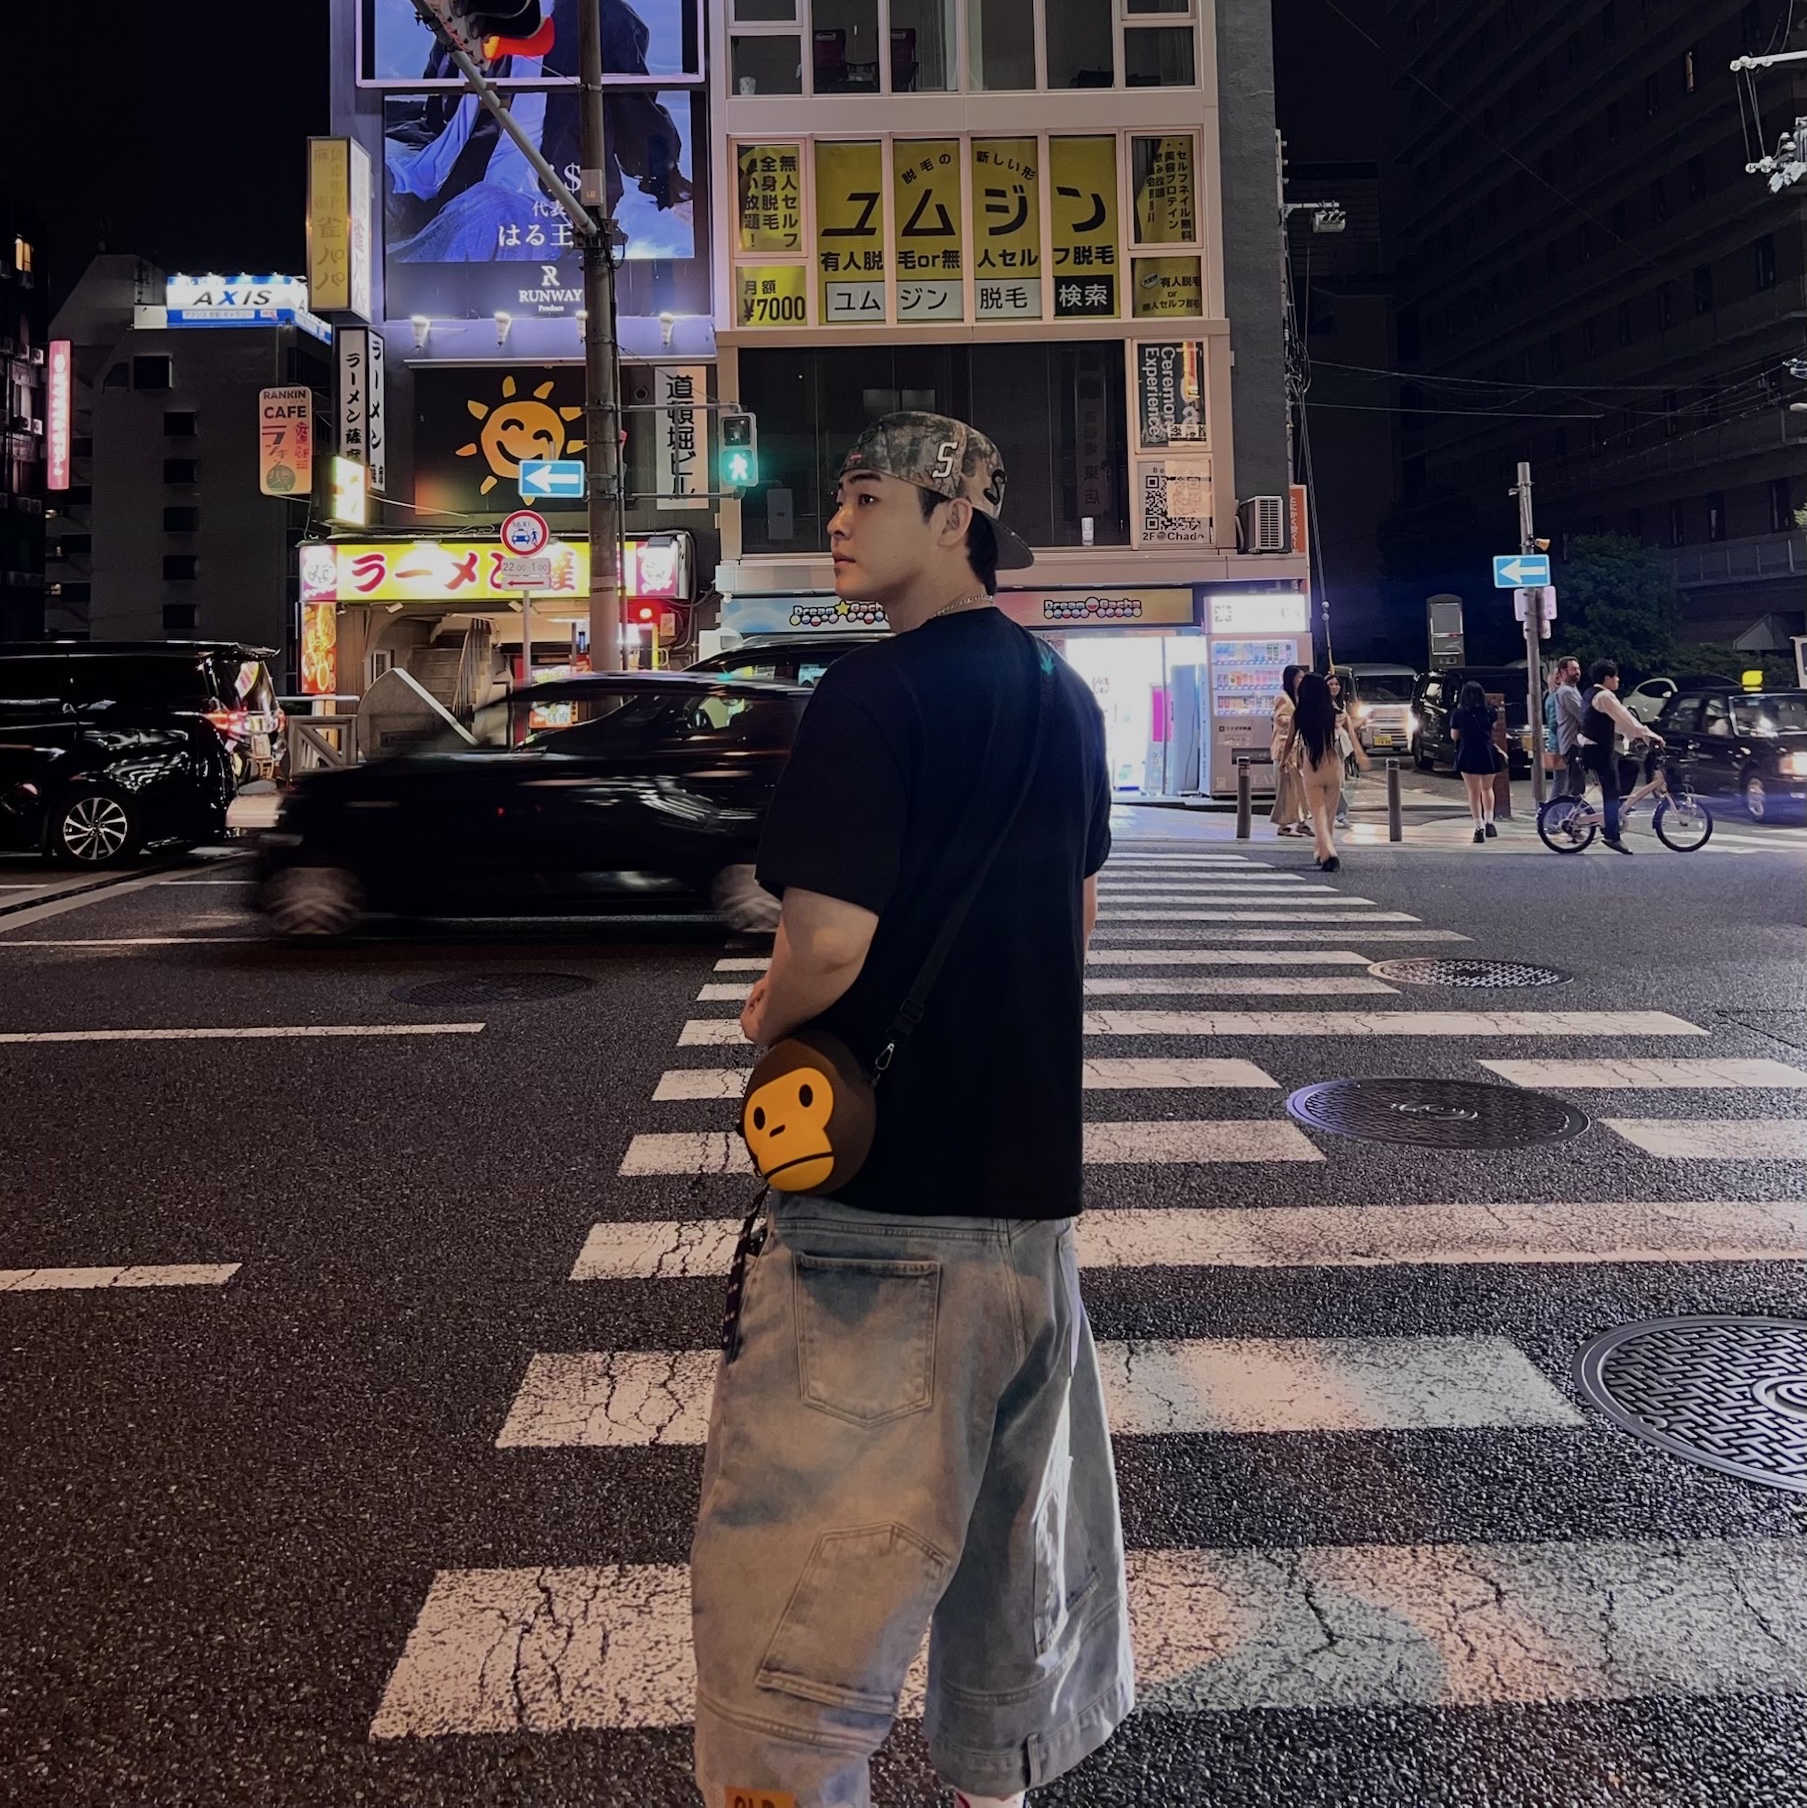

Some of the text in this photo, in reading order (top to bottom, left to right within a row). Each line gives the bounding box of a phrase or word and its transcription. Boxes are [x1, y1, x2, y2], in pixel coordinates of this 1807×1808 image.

[901, 150, 1037, 185] 脱毛の 新しい形
[760, 155, 780, 231] 全身脱毛
[780, 155, 798, 248] 無人セルフ
[192, 290, 273, 306] AXIS
[518, 288, 583, 302] RUNWAY
[744, 279, 776, 296] 月額
[979, 286, 1028, 310] 脱毛
[1058, 283, 1108, 308] 検索
[538, 304, 565, 312] Produce
[743, 295, 806, 322] ¥7000
[263, 389, 307, 400] RANKIN
[369, 340, 382, 450] ラーメン
[1142, 346, 1160, 437] Experience
[263, 405, 307, 419] CAFE
[666, 374, 697, 500] 道頓堀ビル
[793, 604, 836, 616] Dream
[1044, 598, 1142, 610] Dream Gacha
